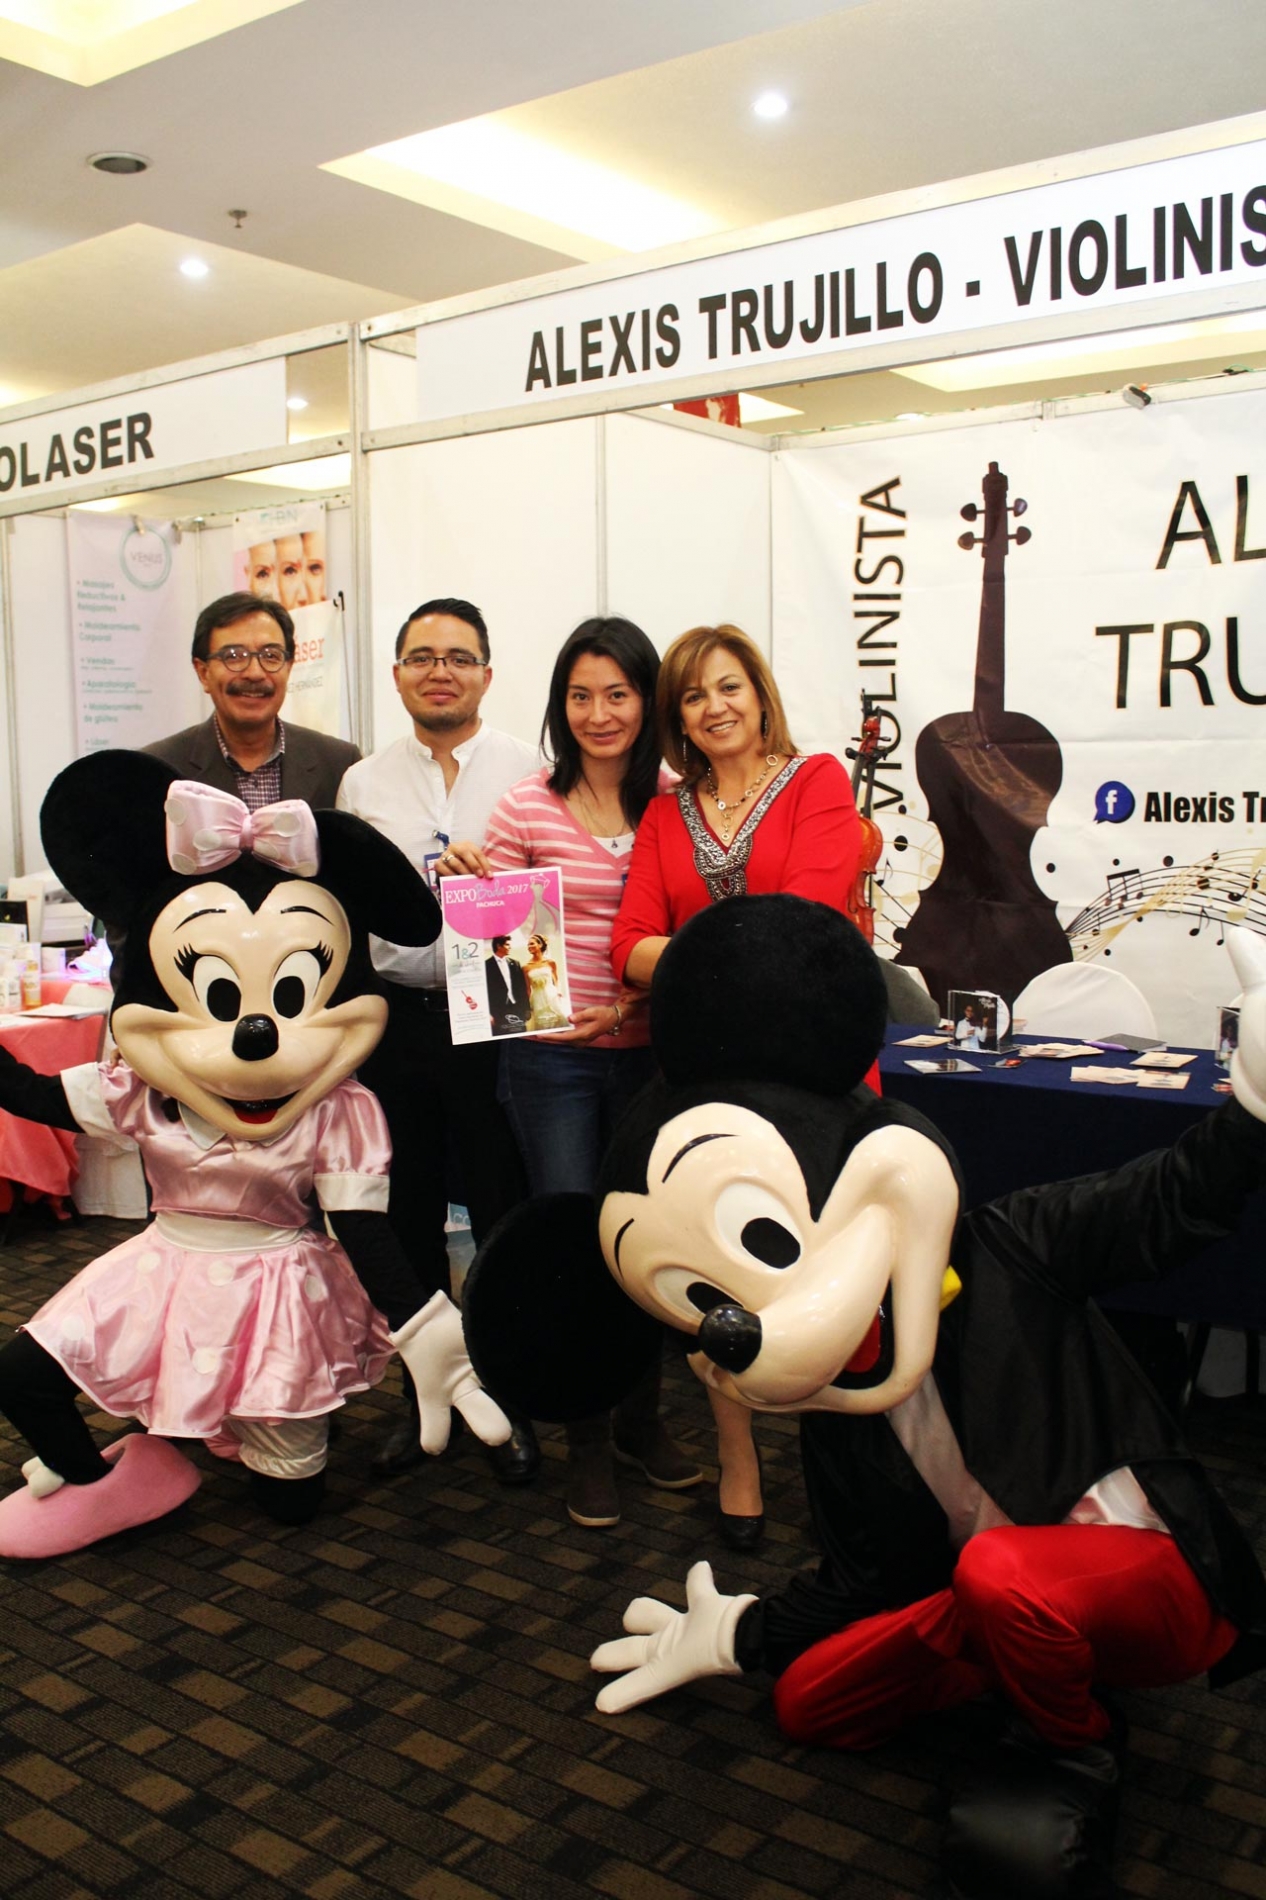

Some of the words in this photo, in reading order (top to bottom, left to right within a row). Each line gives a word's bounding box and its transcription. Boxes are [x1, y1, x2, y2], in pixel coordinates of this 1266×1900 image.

[525, 302, 681, 393] ALEXIS
[699, 251, 944, 360] TRUJILLO
[1004, 184, 1266, 307] VIOLINIS
[0, 412, 154, 492] OLASER
[1155, 475, 1266, 570] AL
[853, 476, 908, 814] VIOLINISTA
[1095, 617, 1266, 708] TRU
[1144, 791, 1235, 823] Alexis
[476, 900, 505, 908] PACHUCA
[507, 884, 529, 895] 2017
